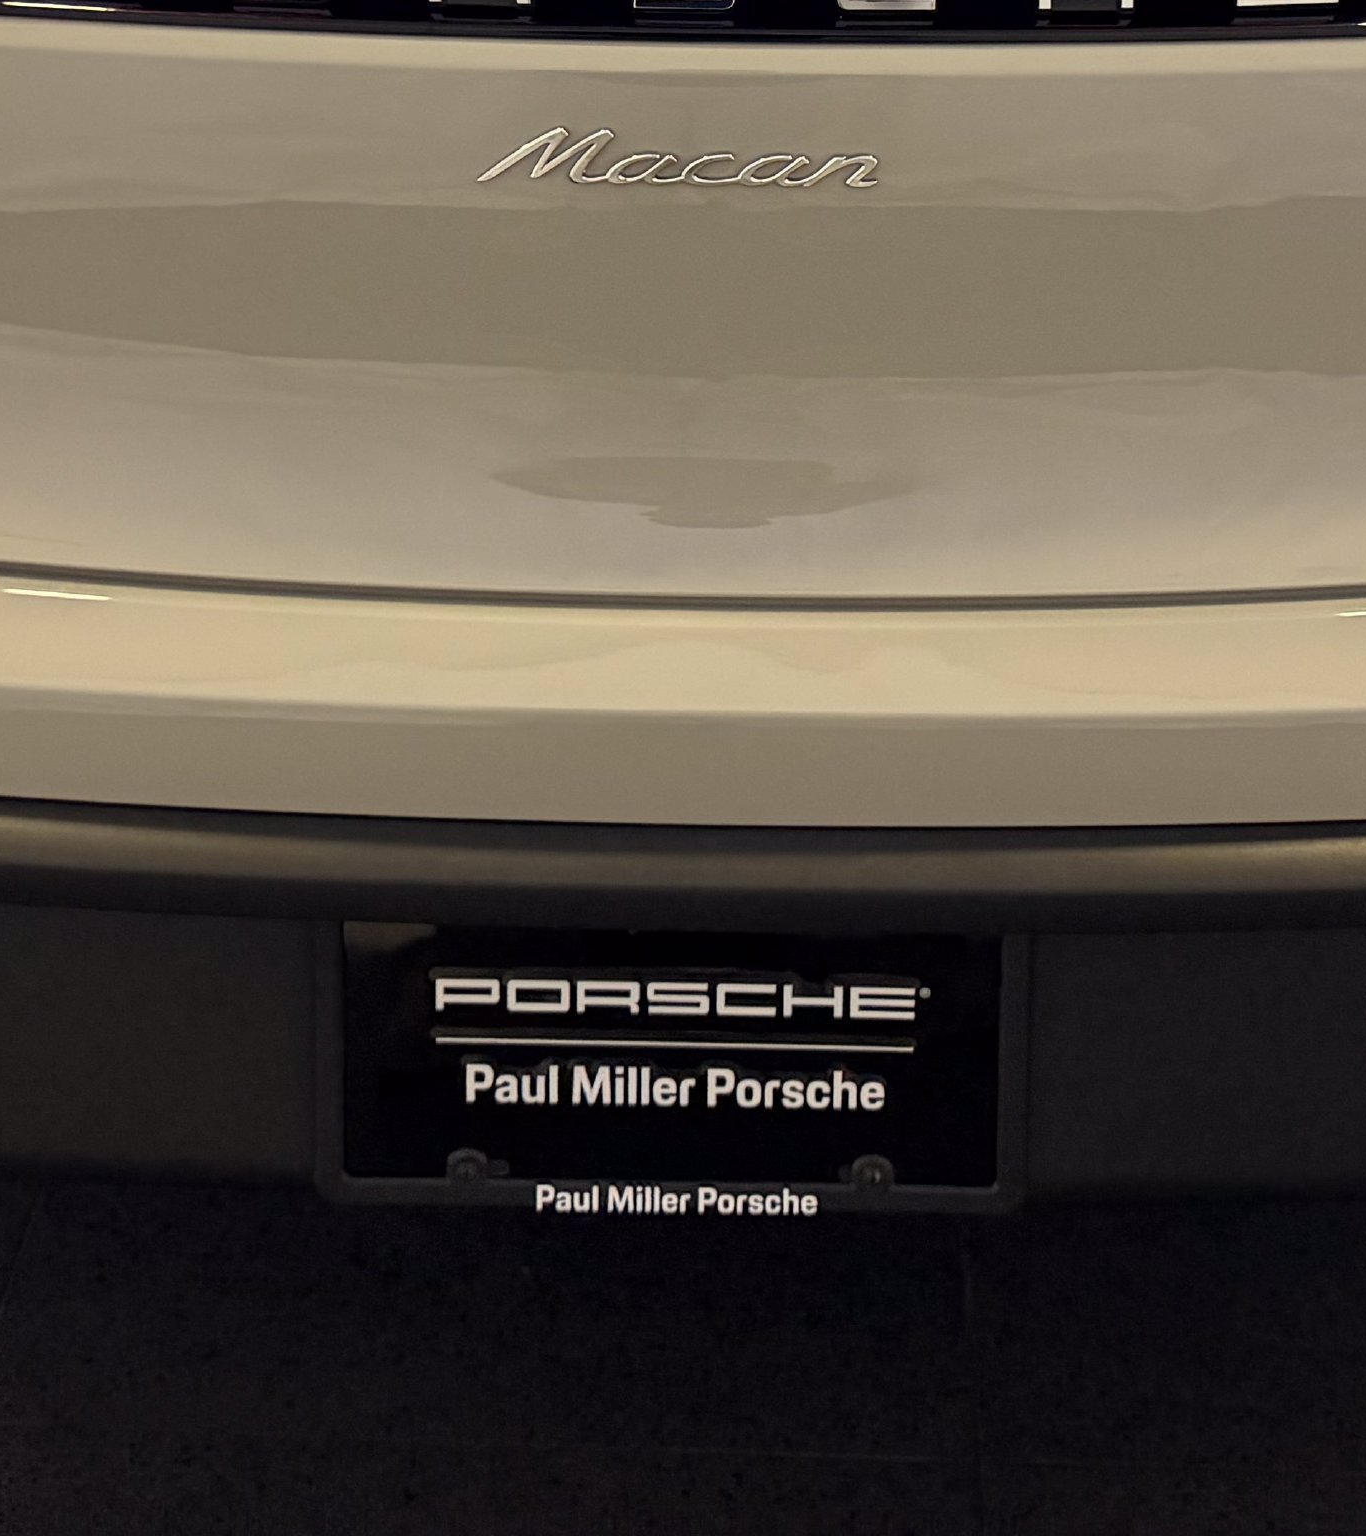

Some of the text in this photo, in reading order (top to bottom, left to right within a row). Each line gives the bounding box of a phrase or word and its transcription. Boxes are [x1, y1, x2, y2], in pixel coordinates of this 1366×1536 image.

[477, 126, 877, 188] Macan
[435, 978, 916, 1021] PORSCHE
[466, 1064, 886, 1111] Paul Miller Porsche
[536, 1184, 818, 1217] Paul Miller Porsche
